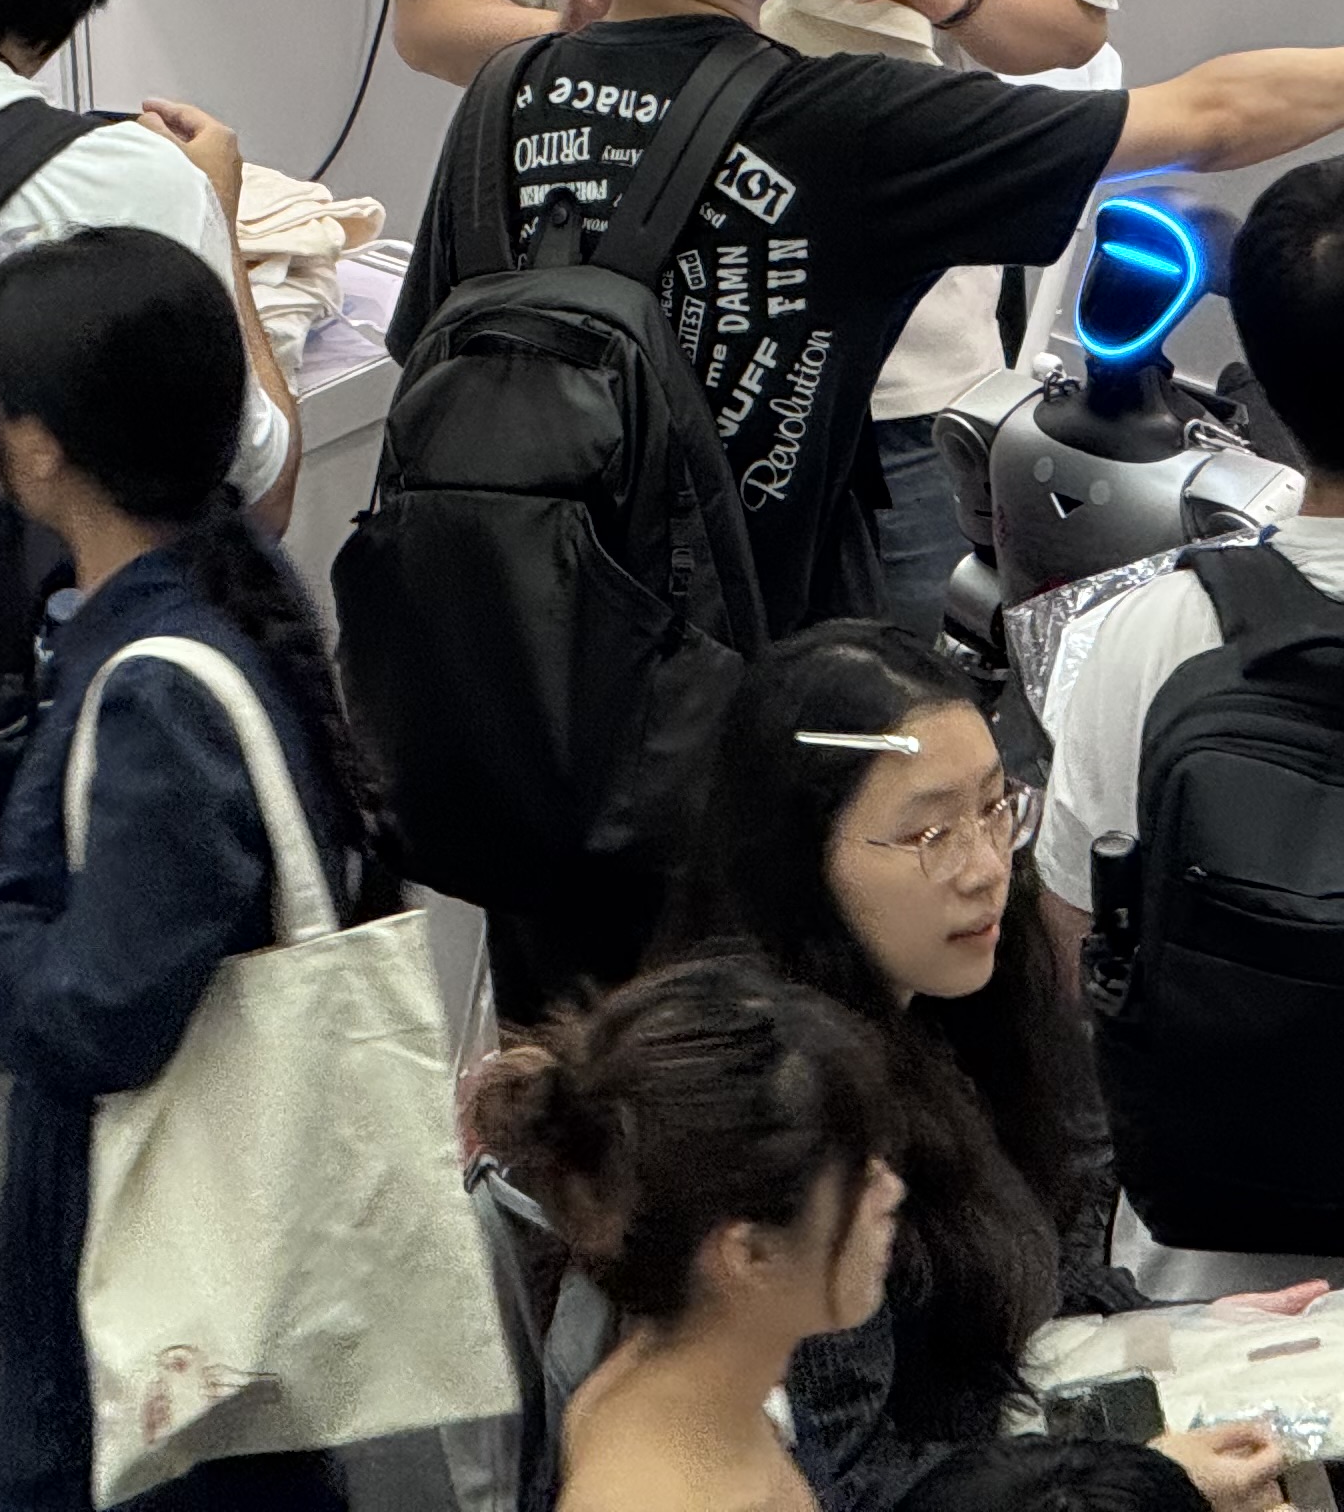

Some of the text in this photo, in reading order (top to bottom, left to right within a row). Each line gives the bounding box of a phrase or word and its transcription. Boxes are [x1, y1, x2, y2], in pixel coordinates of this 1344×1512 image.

[548, 76, 672, 123] enace
[514, 126, 592, 173] PRIMO
[681, 253, 704, 287] and
[717, 246, 750, 333] DAMN
[767, 239, 808, 319] FUN
[706, 344, 727, 387] me
[717, 337, 779, 450] NUFF
[741, 330, 833, 512] Revolution
